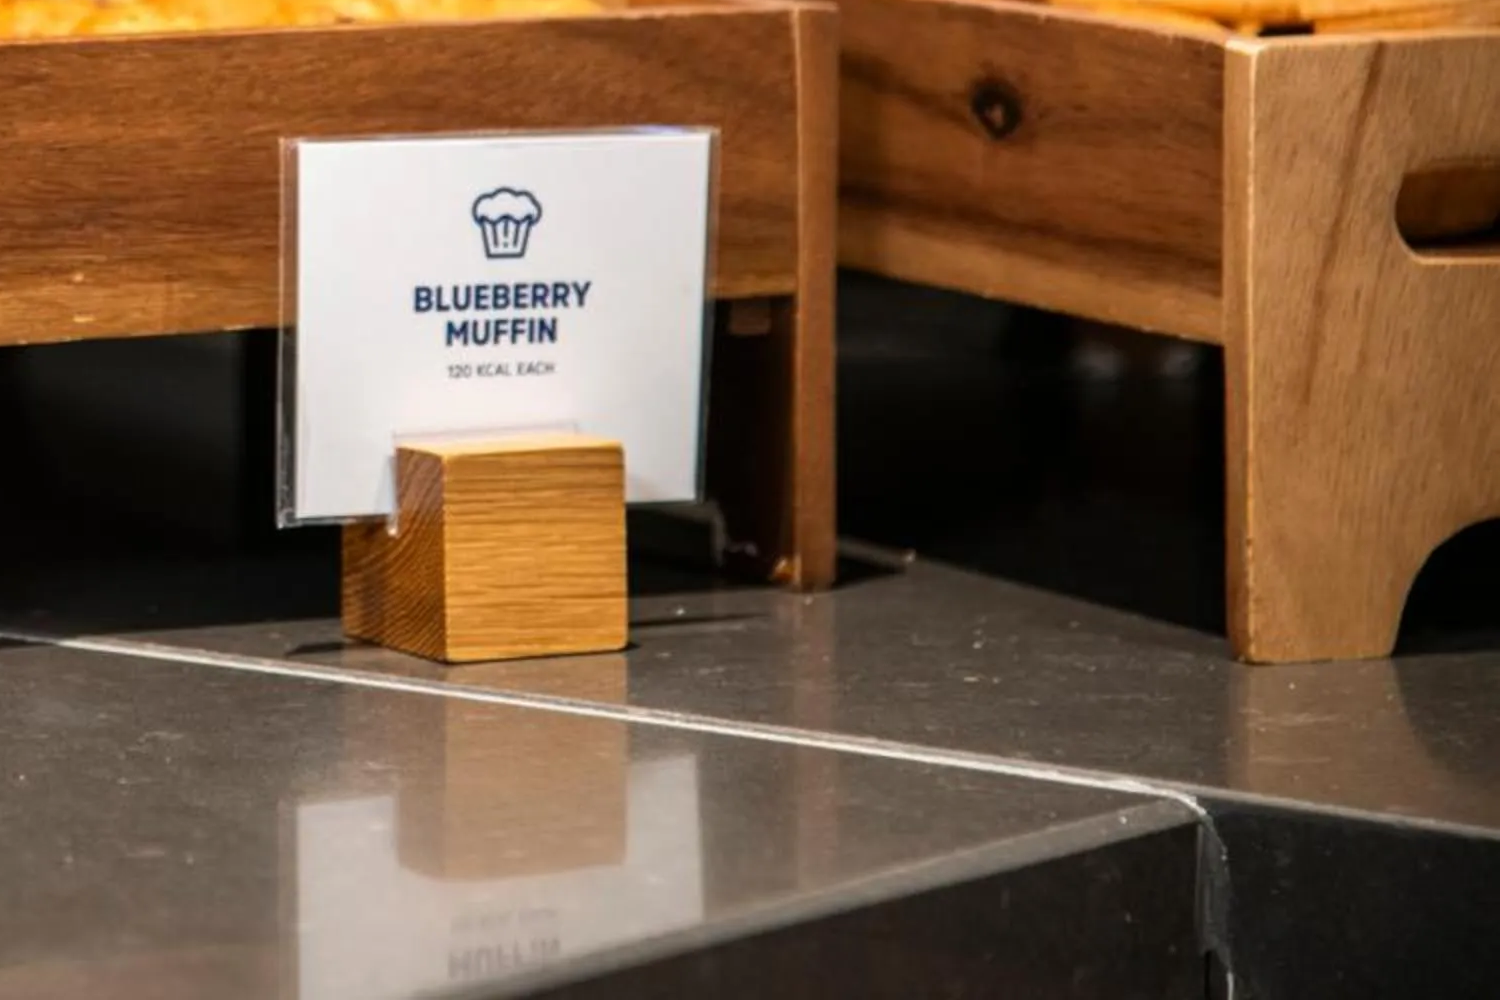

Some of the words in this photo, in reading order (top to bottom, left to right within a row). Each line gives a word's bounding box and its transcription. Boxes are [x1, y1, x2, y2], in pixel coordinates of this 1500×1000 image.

[413, 281, 592, 312] BLUEBERRY
[445, 317, 558, 347] MUFFIN
[448, 363, 472, 379] 120
[477, 362, 512, 377] KCAL
[517, 361, 556, 375] EACH
